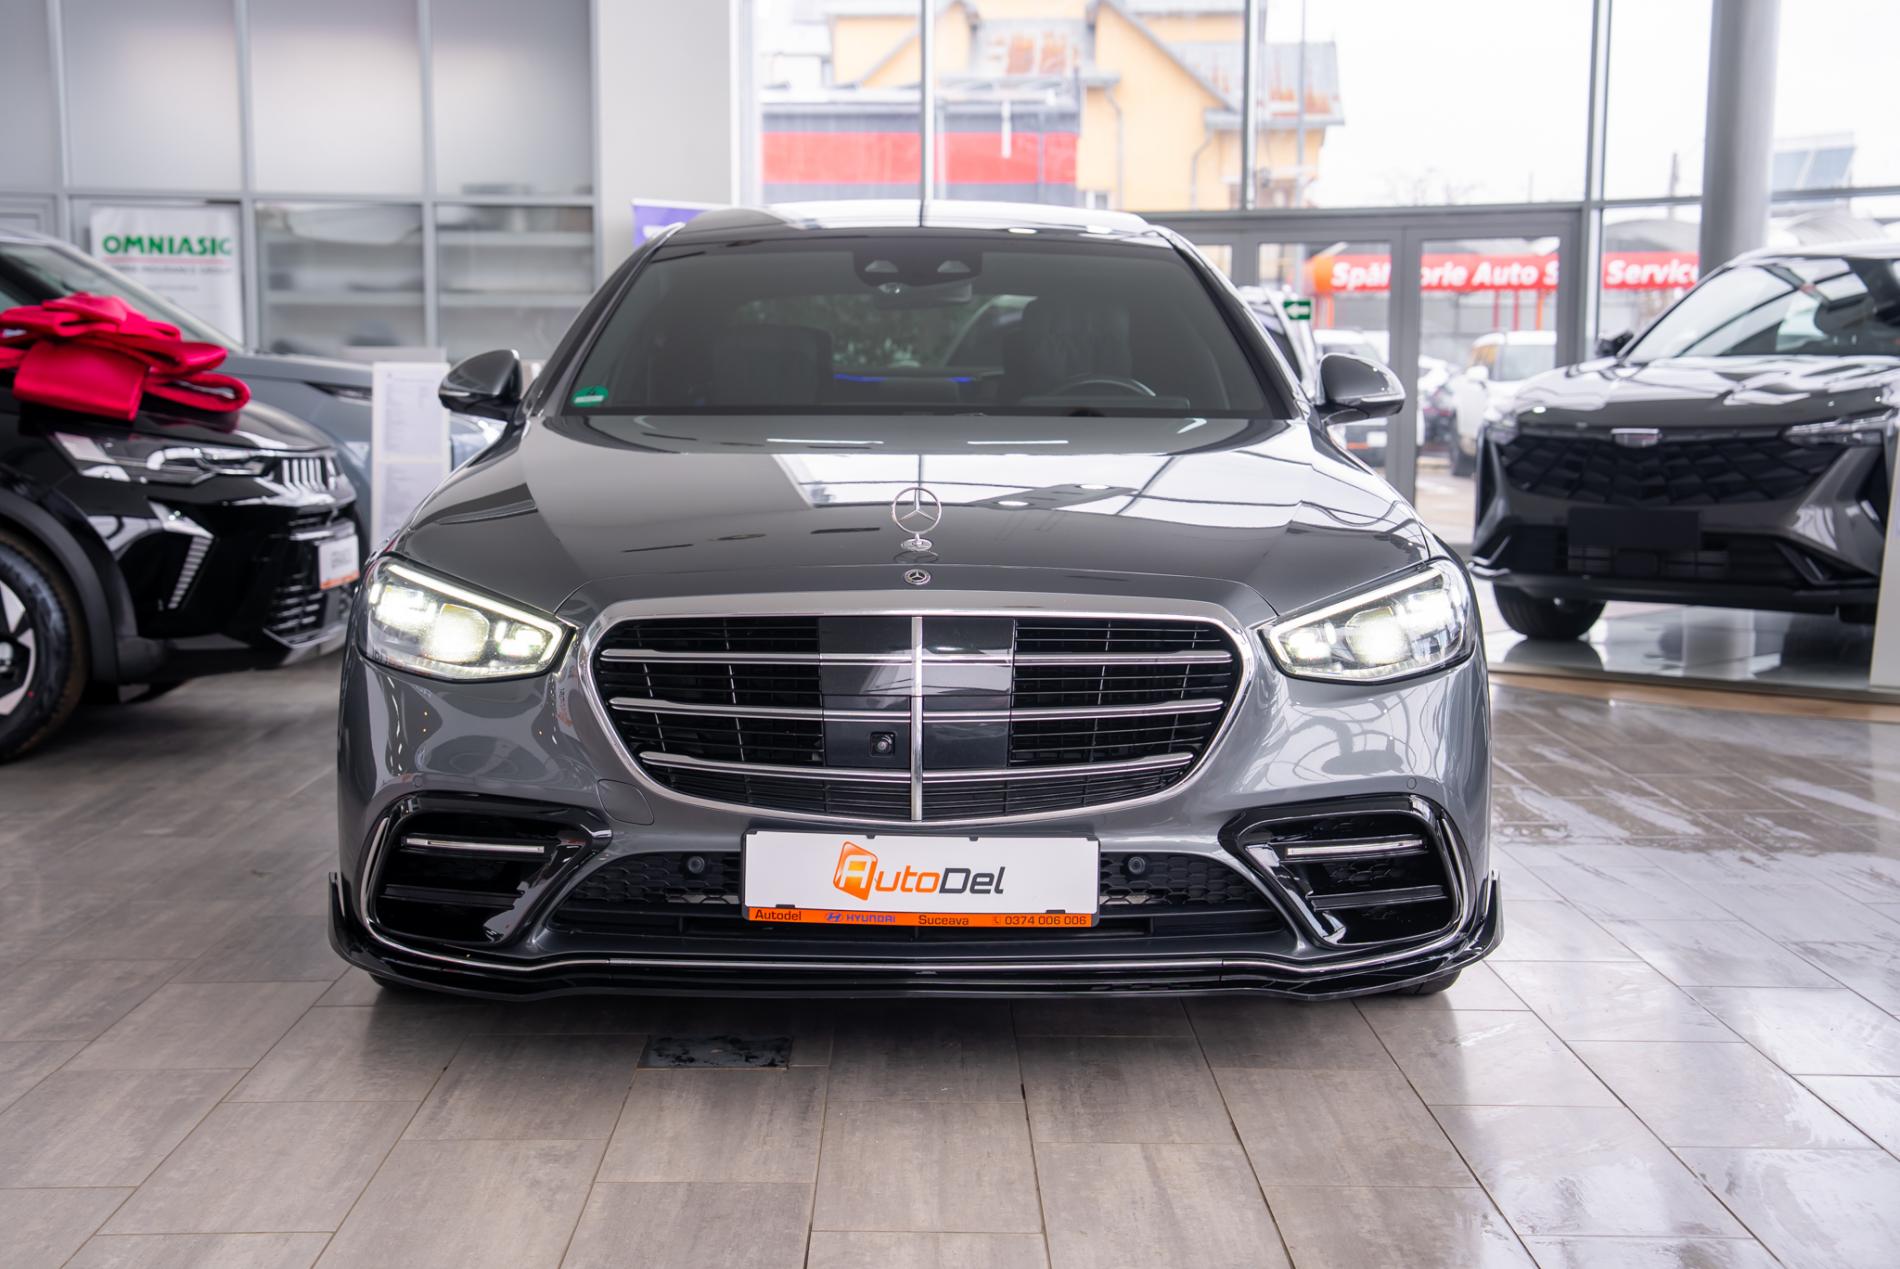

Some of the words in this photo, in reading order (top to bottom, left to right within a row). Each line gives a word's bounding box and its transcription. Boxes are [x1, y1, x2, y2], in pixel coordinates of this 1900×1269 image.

[103, 235, 232, 255] OMNIASIC
[1471, 261, 1539, 286] Auto
[836, 849, 1006, 897] AutoDel
[754, 909, 802, 921] Autodel
[846, 913, 896, 923] HYUNDAI
[918, 914, 969, 926] Suceava
[1004, 915, 1035, 926] 0374
[1038, 915, 1061, 926] 006
[1063, 915, 1087, 926] 006
